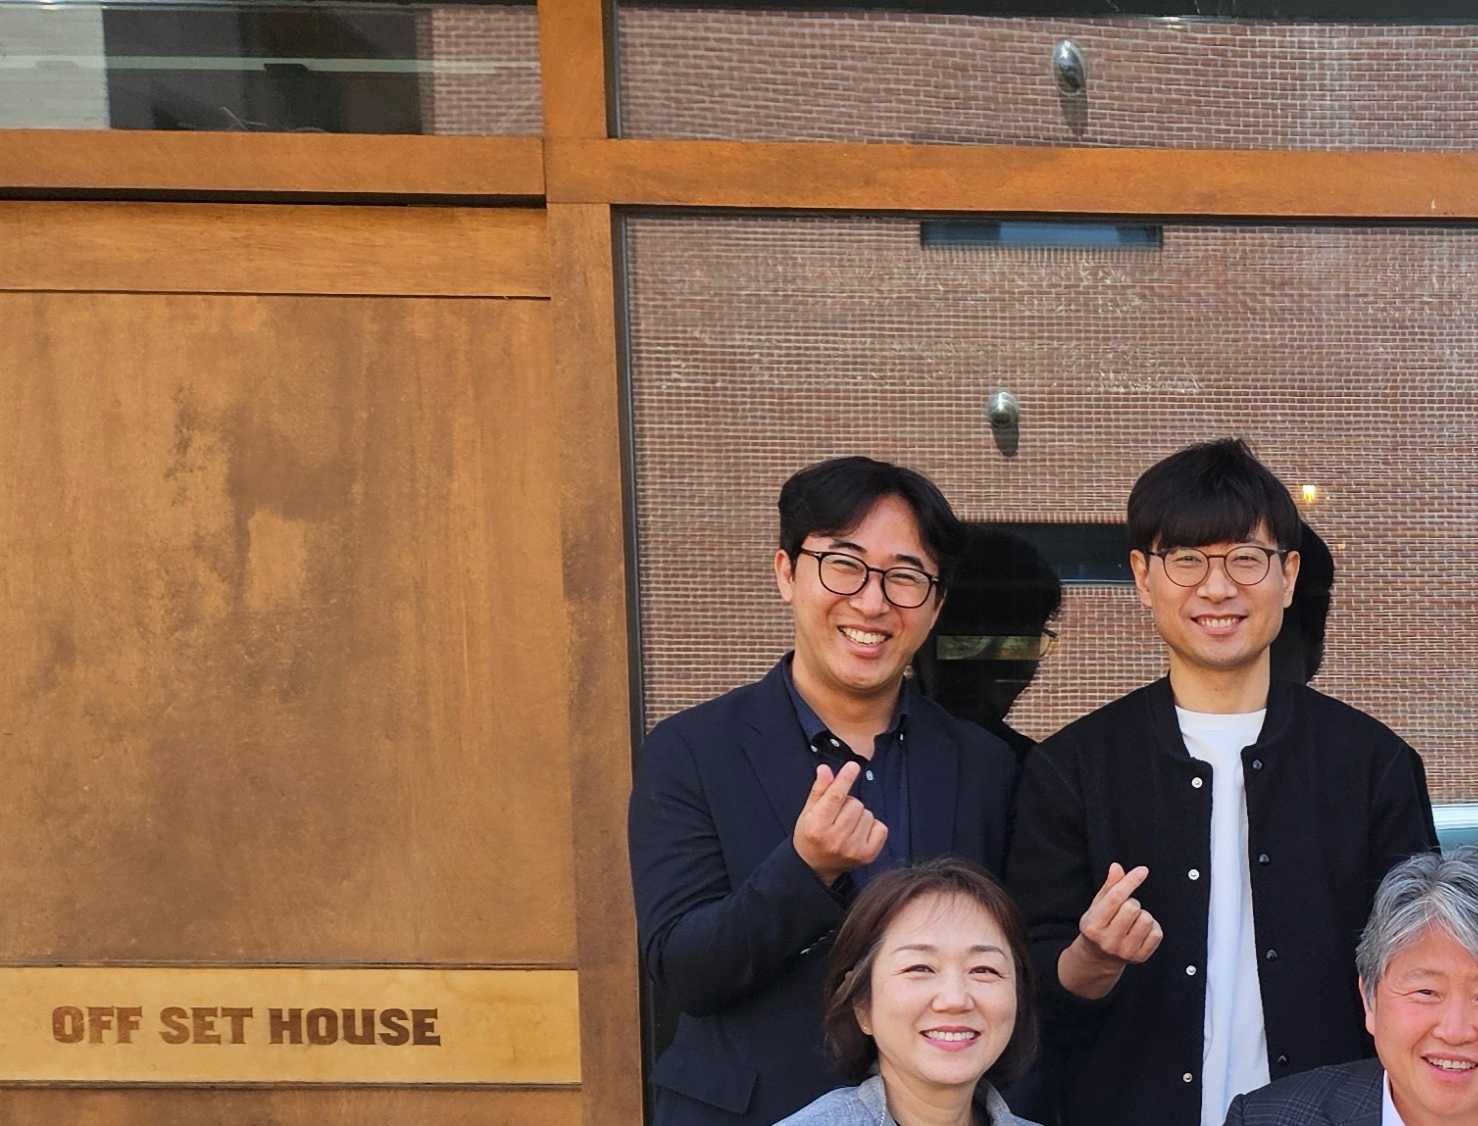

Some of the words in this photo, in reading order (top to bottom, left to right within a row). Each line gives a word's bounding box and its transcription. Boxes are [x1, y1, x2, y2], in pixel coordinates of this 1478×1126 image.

[51, 1005, 143, 1044] OFF
[158, 1006, 254, 1045] SET
[267, 1007, 442, 1047] HOUSE
